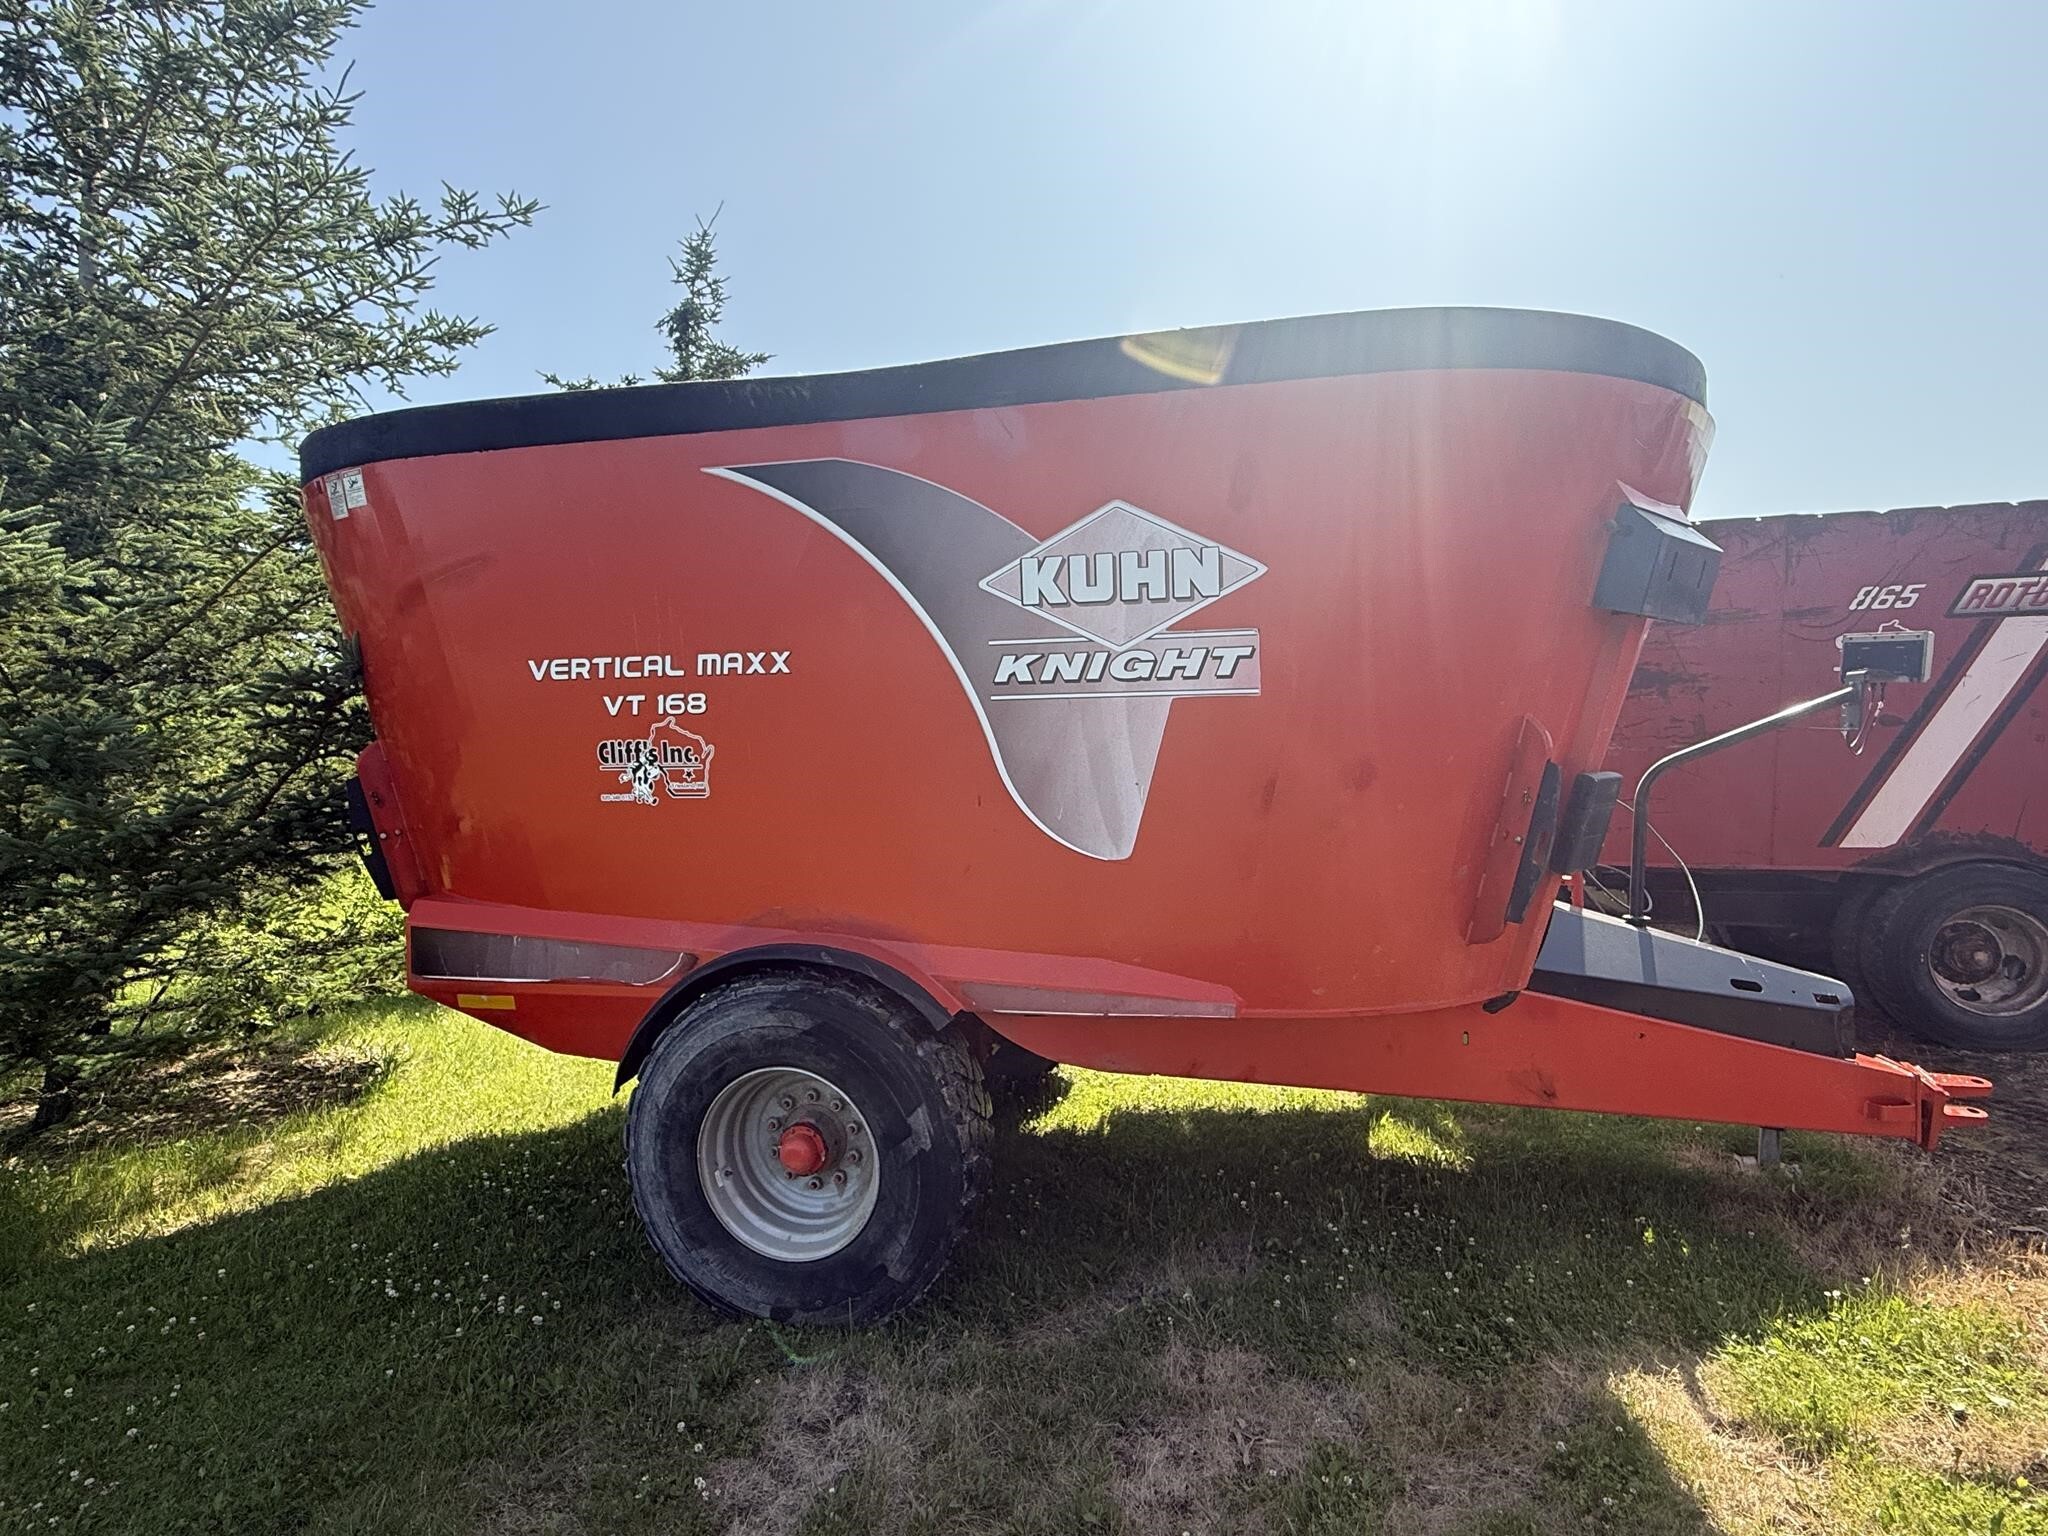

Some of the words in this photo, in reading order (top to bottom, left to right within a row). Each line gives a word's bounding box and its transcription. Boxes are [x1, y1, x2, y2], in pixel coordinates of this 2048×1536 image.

[1020, 546, 1223, 607] KUHN
[528, 655, 685, 681] VERTICAL
[697, 651, 792, 676] MAXX
[992, 646, 1256, 686] KNIGHT
[603, 694, 646, 716] VT
[657, 693, 708, 715] 168
[598, 741, 658, 765] Cliff's
[662, 740, 700, 764] Inc.
